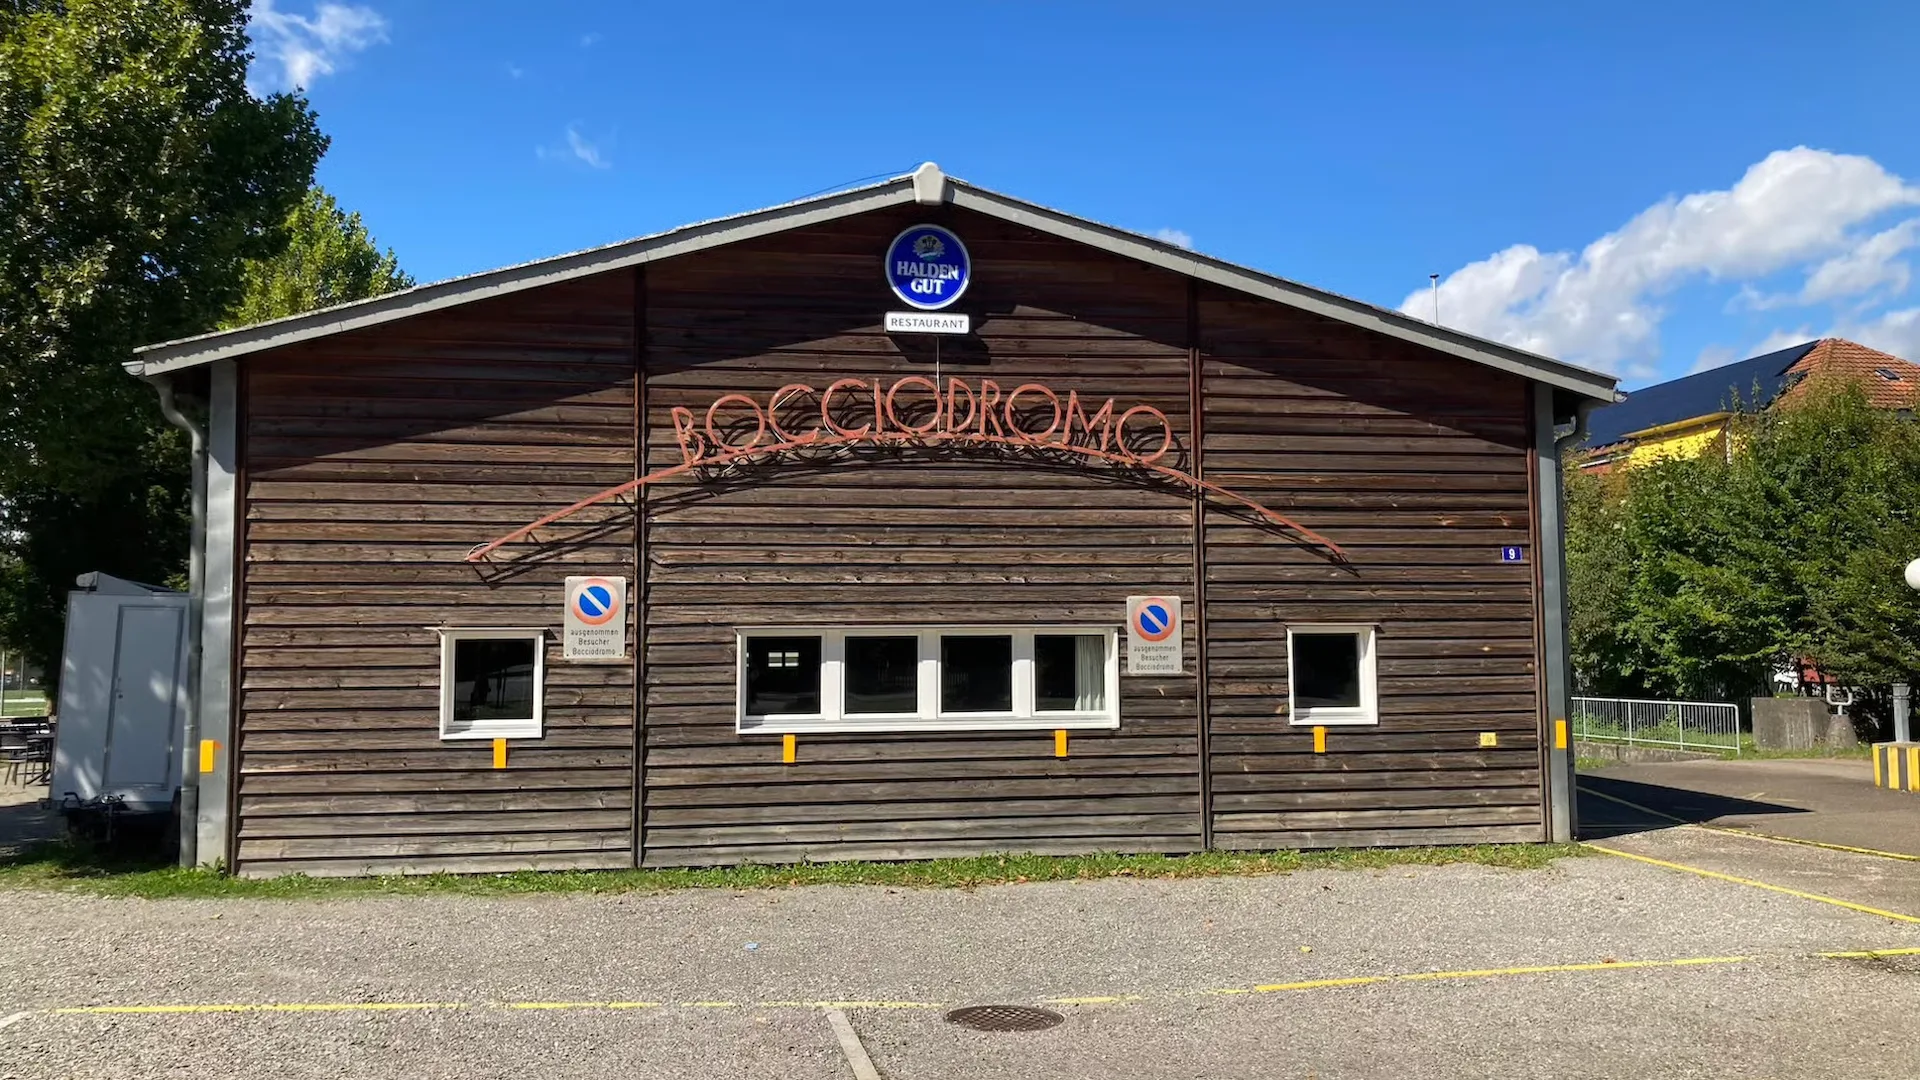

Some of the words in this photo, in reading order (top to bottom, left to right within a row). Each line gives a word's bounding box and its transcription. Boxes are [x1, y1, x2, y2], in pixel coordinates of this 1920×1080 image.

[896, 261, 960, 280] HALDEN
[910, 278, 945, 295] GUT
[891, 318, 964, 328] RESTAURANT
[670, 376, 1172, 466] BOCCIODROMO
[1508, 548, 1515, 560] 9
[578, 638, 610, 646] Besucher
[572, 647, 616, 655] Bocciodromo
